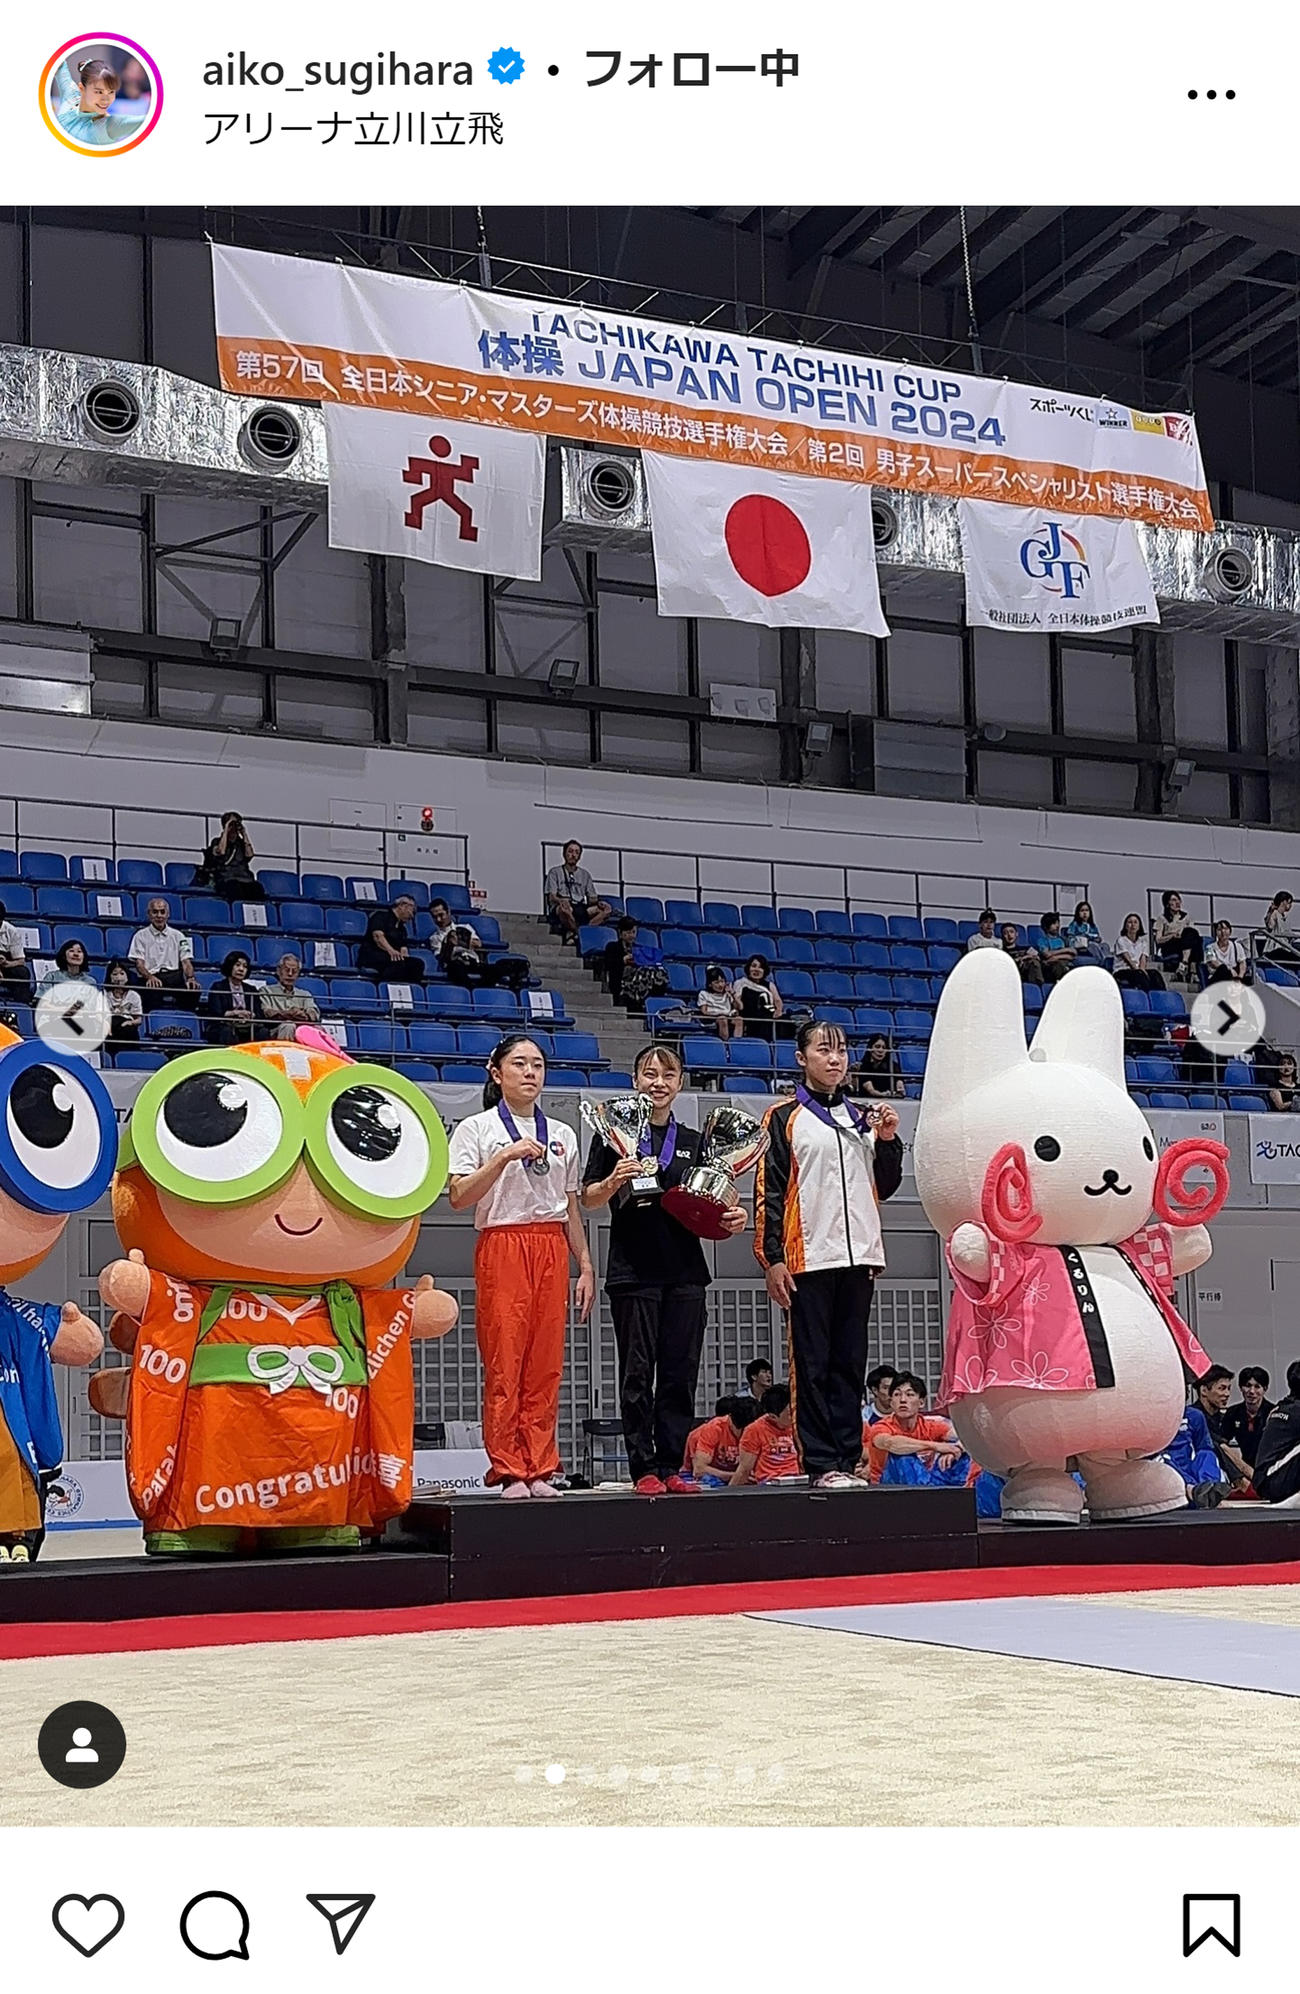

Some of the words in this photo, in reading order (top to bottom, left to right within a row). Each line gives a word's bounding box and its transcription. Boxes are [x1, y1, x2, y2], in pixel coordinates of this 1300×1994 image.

[478, 329, 565, 377] 体操
[578, 350, 742, 404] JAPAN
[755, 377, 878, 427] OPEN
[891, 401, 1007, 447] 2024
[532, 309, 739, 367] TACHIKAWA
[747, 347, 884, 393] TACHIHI
[894, 374, 962, 403] CUP
[236, 350, 325, 385] 第57回
[876, 447, 1202, 520] 男子スーパースペシャリスト選手権大会
[1067, 1252, 1096, 1314] くるりん
[139, 1343, 187, 1384] 100
